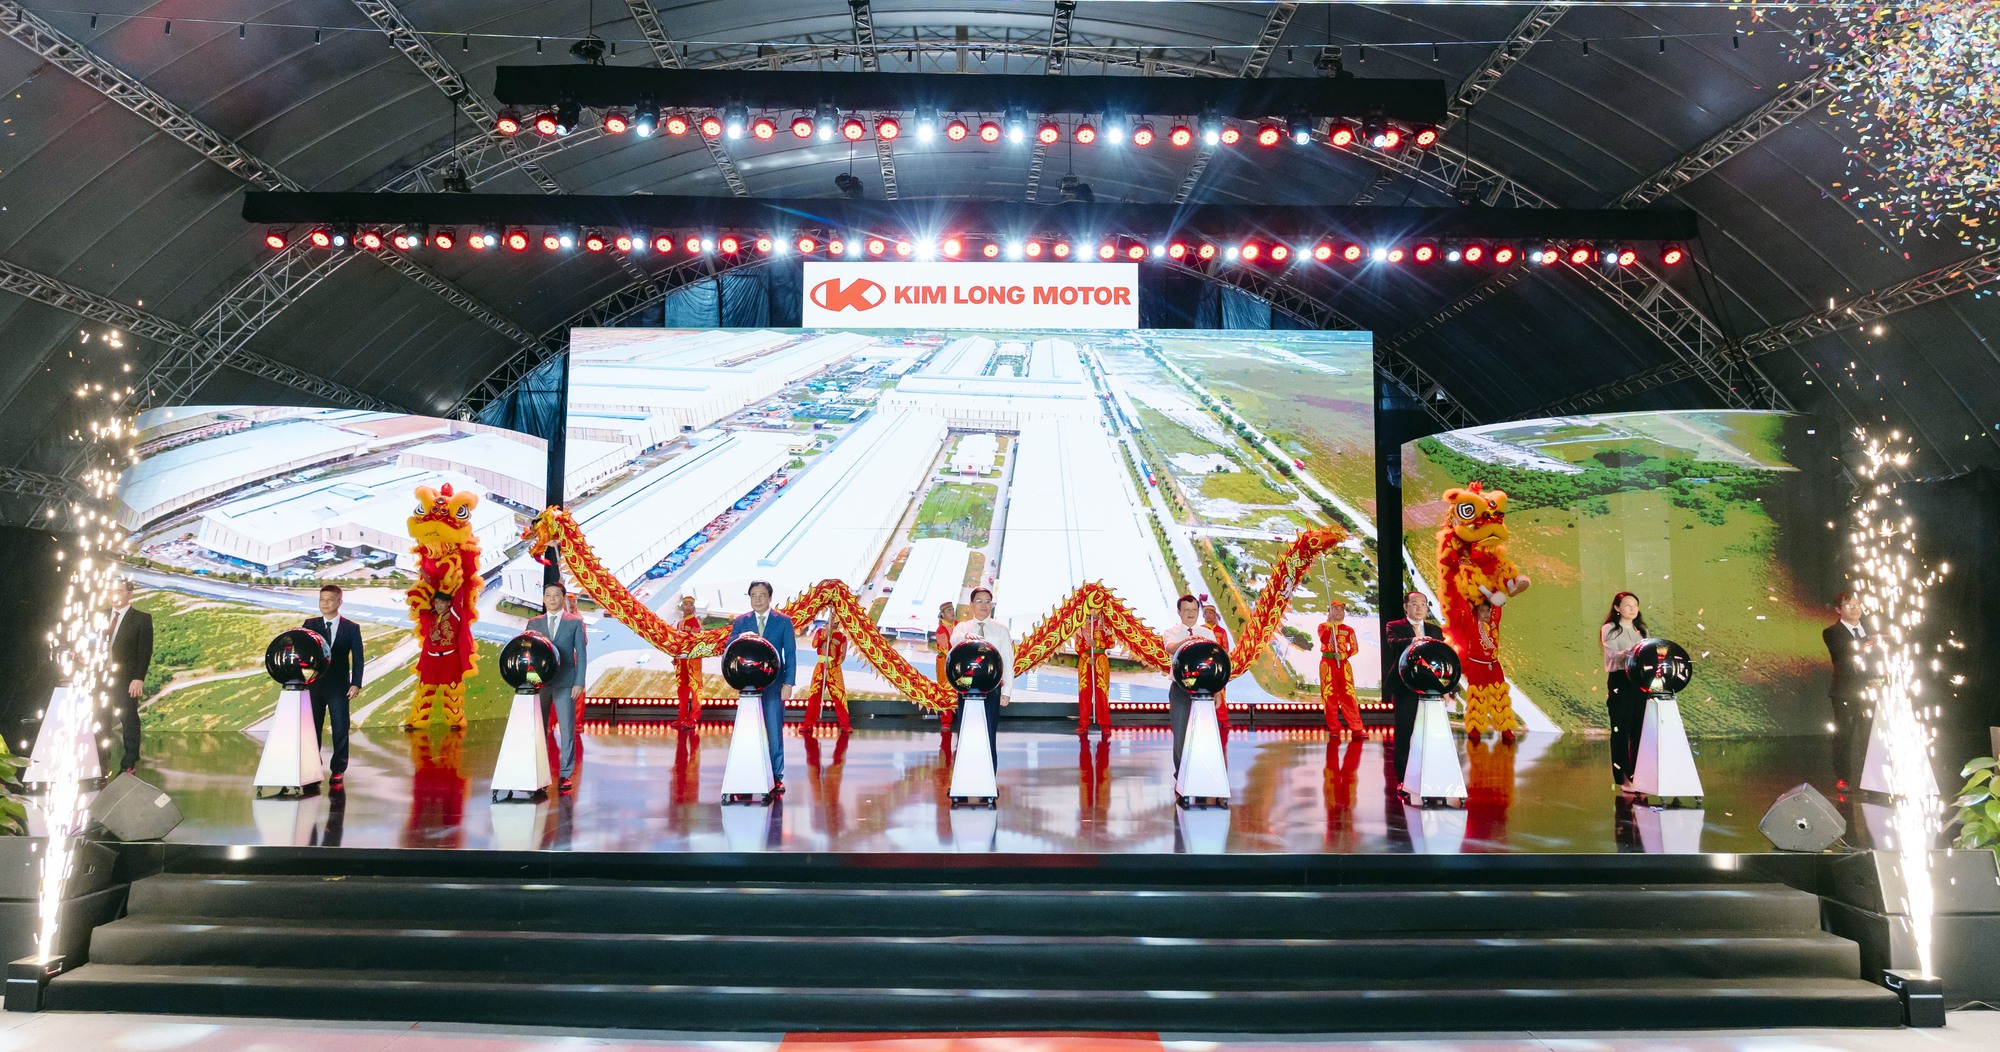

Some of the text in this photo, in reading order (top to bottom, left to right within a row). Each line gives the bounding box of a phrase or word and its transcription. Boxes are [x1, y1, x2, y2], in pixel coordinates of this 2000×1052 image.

[894, 285, 947, 305] KIM
[954, 285, 1026, 305] LONG
[1034, 285, 1131, 306] MOTOR
